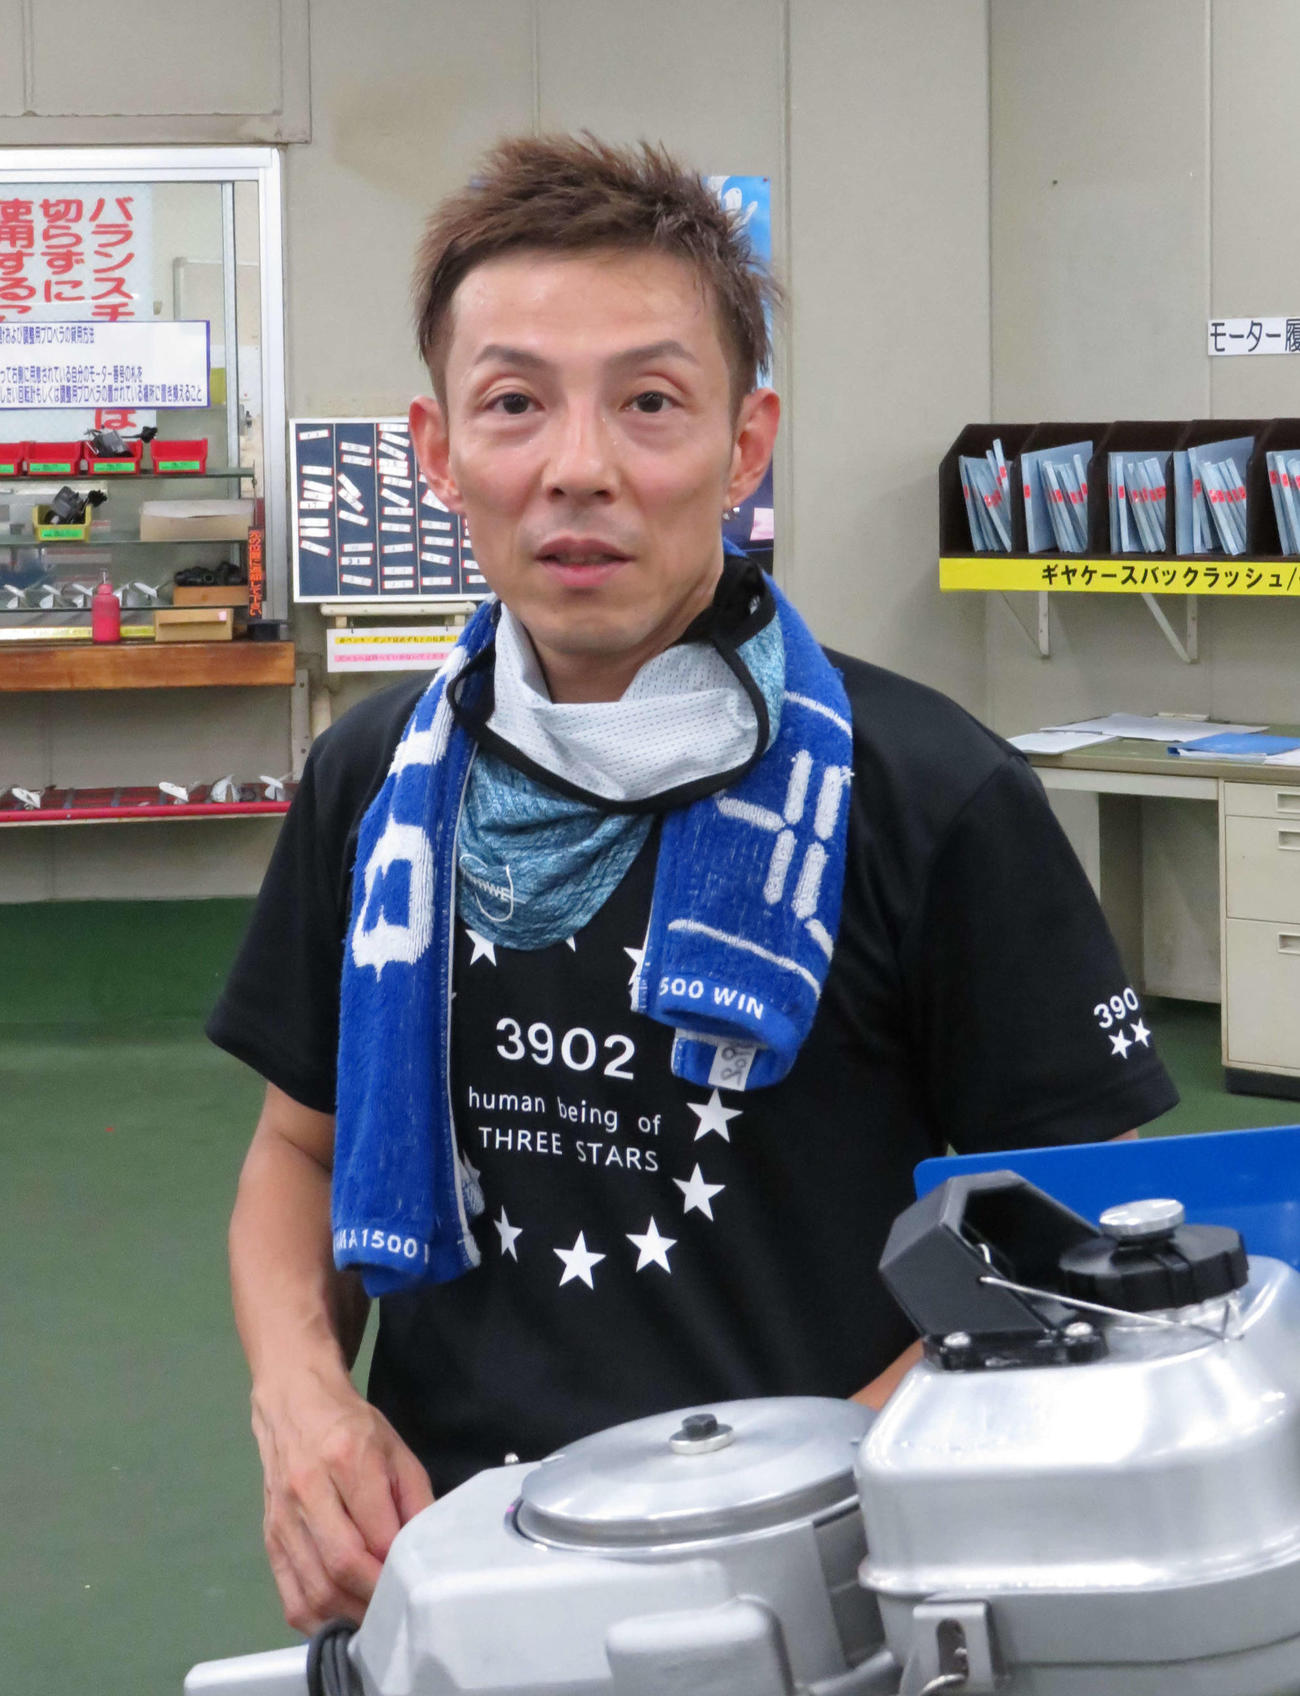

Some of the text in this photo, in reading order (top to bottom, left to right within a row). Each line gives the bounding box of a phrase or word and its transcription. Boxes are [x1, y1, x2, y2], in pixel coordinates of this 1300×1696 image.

[39, 198, 85, 302] 切らずに
[1042, 564, 1300, 591] ギヤケースバックラッシュ/
[713, 987, 764, 1019] WIN
[1094, 987, 1139, 1028] 390
[496, 1017, 635, 1080] 3902
[469, 1086, 661, 1135] human being of
[479, 1127, 659, 1172] THREE STARS
